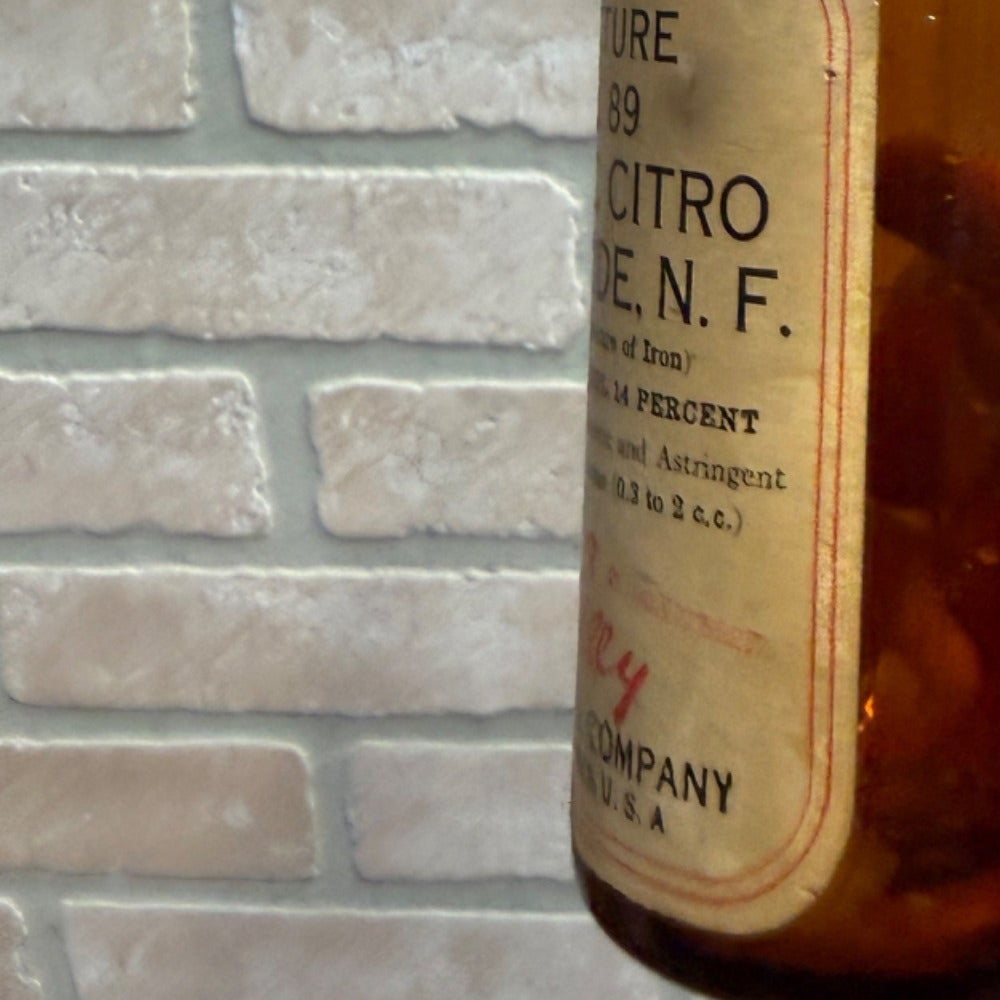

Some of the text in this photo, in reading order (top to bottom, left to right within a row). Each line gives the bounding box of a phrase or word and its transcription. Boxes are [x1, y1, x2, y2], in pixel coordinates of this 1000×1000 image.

[608, 83, 640, 136] 89
[608, 159, 769, 241] CITRO
[657, 255, 709, 328] N.
[736, 266, 792, 338] F.
[622, 335, 637, 359] of
[637, 387, 759, 435] PERCENT
[656, 445, 787, 490] Astringent
[646, 488, 663, 514] to
